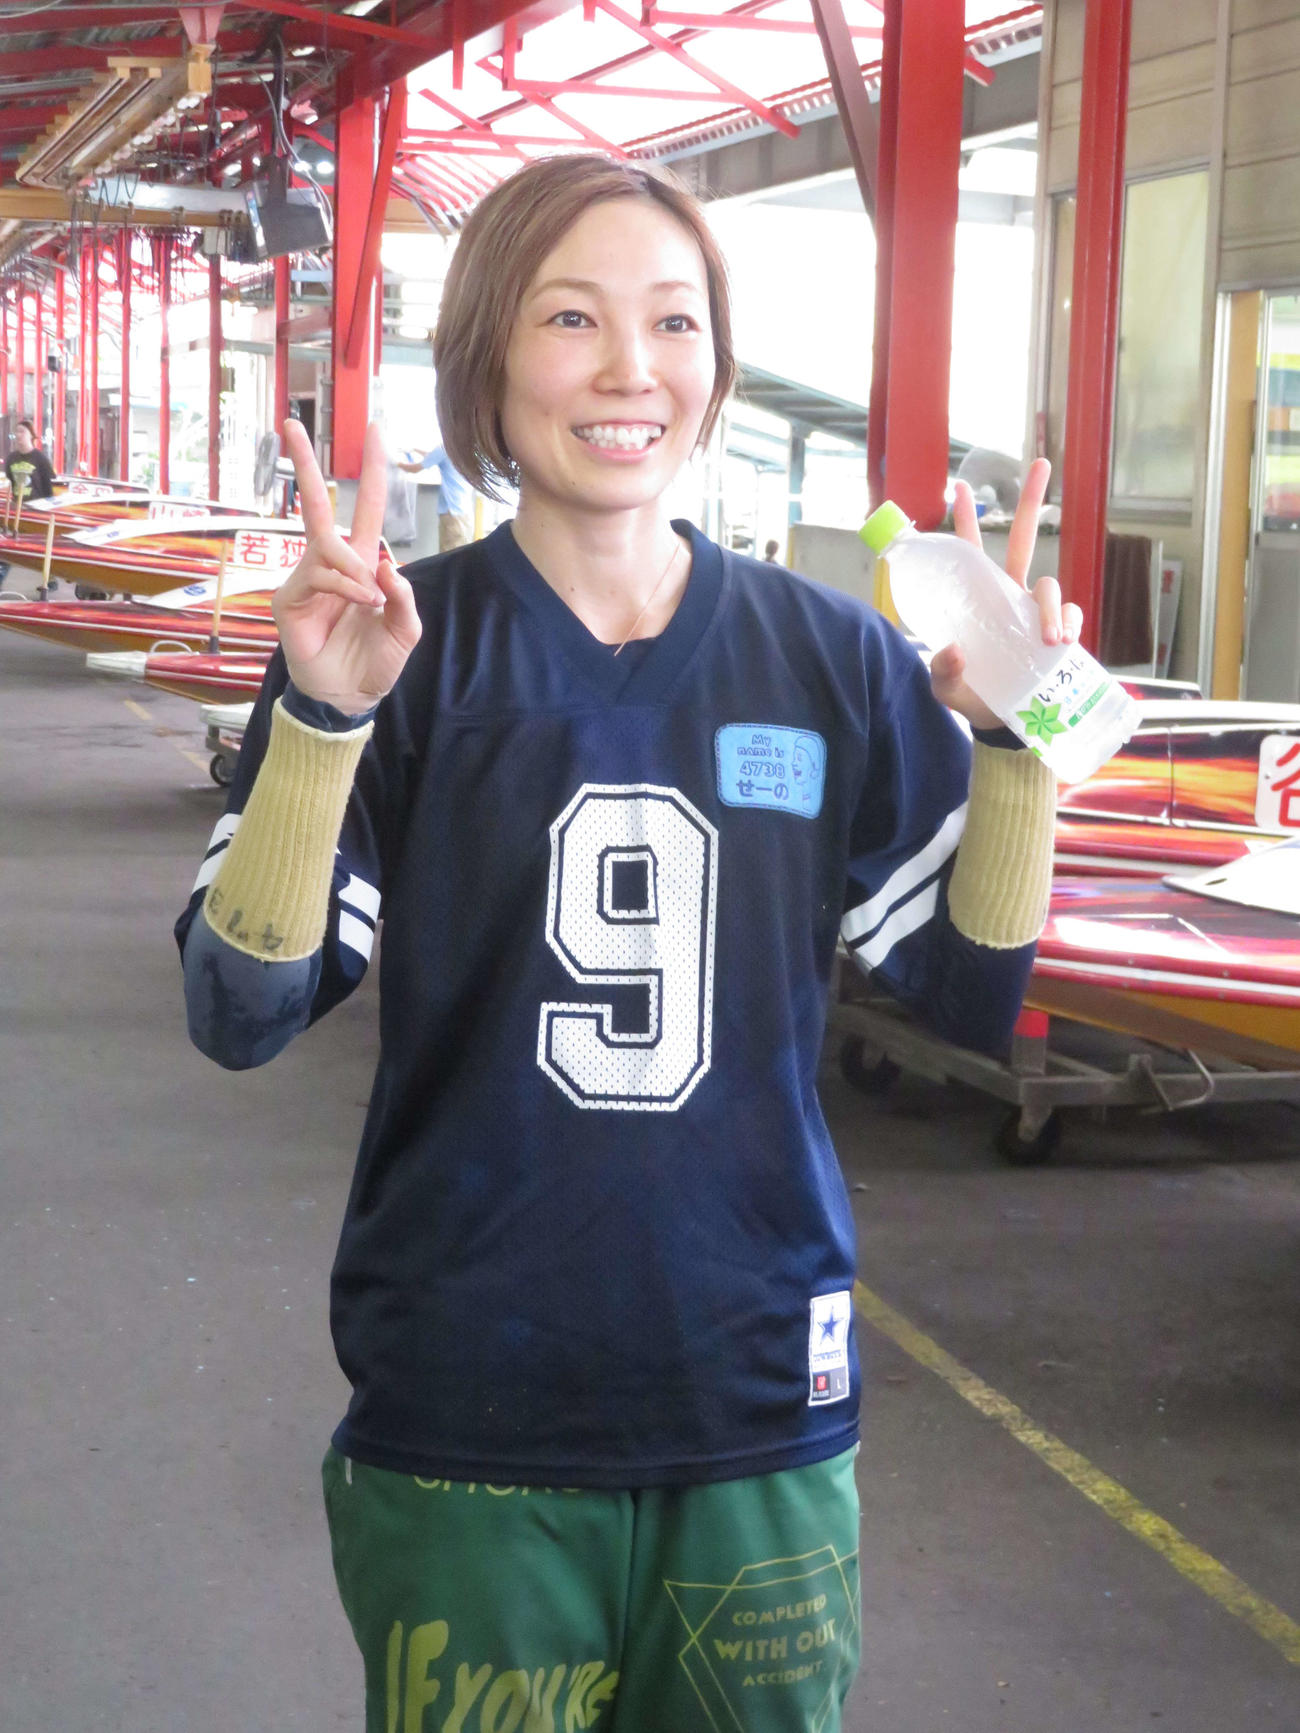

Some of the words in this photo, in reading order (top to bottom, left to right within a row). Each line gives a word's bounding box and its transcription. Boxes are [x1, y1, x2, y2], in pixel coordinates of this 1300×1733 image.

[739, 760, 786, 780] 4738
[735, 779, 790, 802] せーの
[536, 782, 720, 1112] 9
[713, 1635, 788, 1662] WITH
[796, 1618, 836, 1654] OUT
[742, 1660, 824, 1688] ACCIDENT
